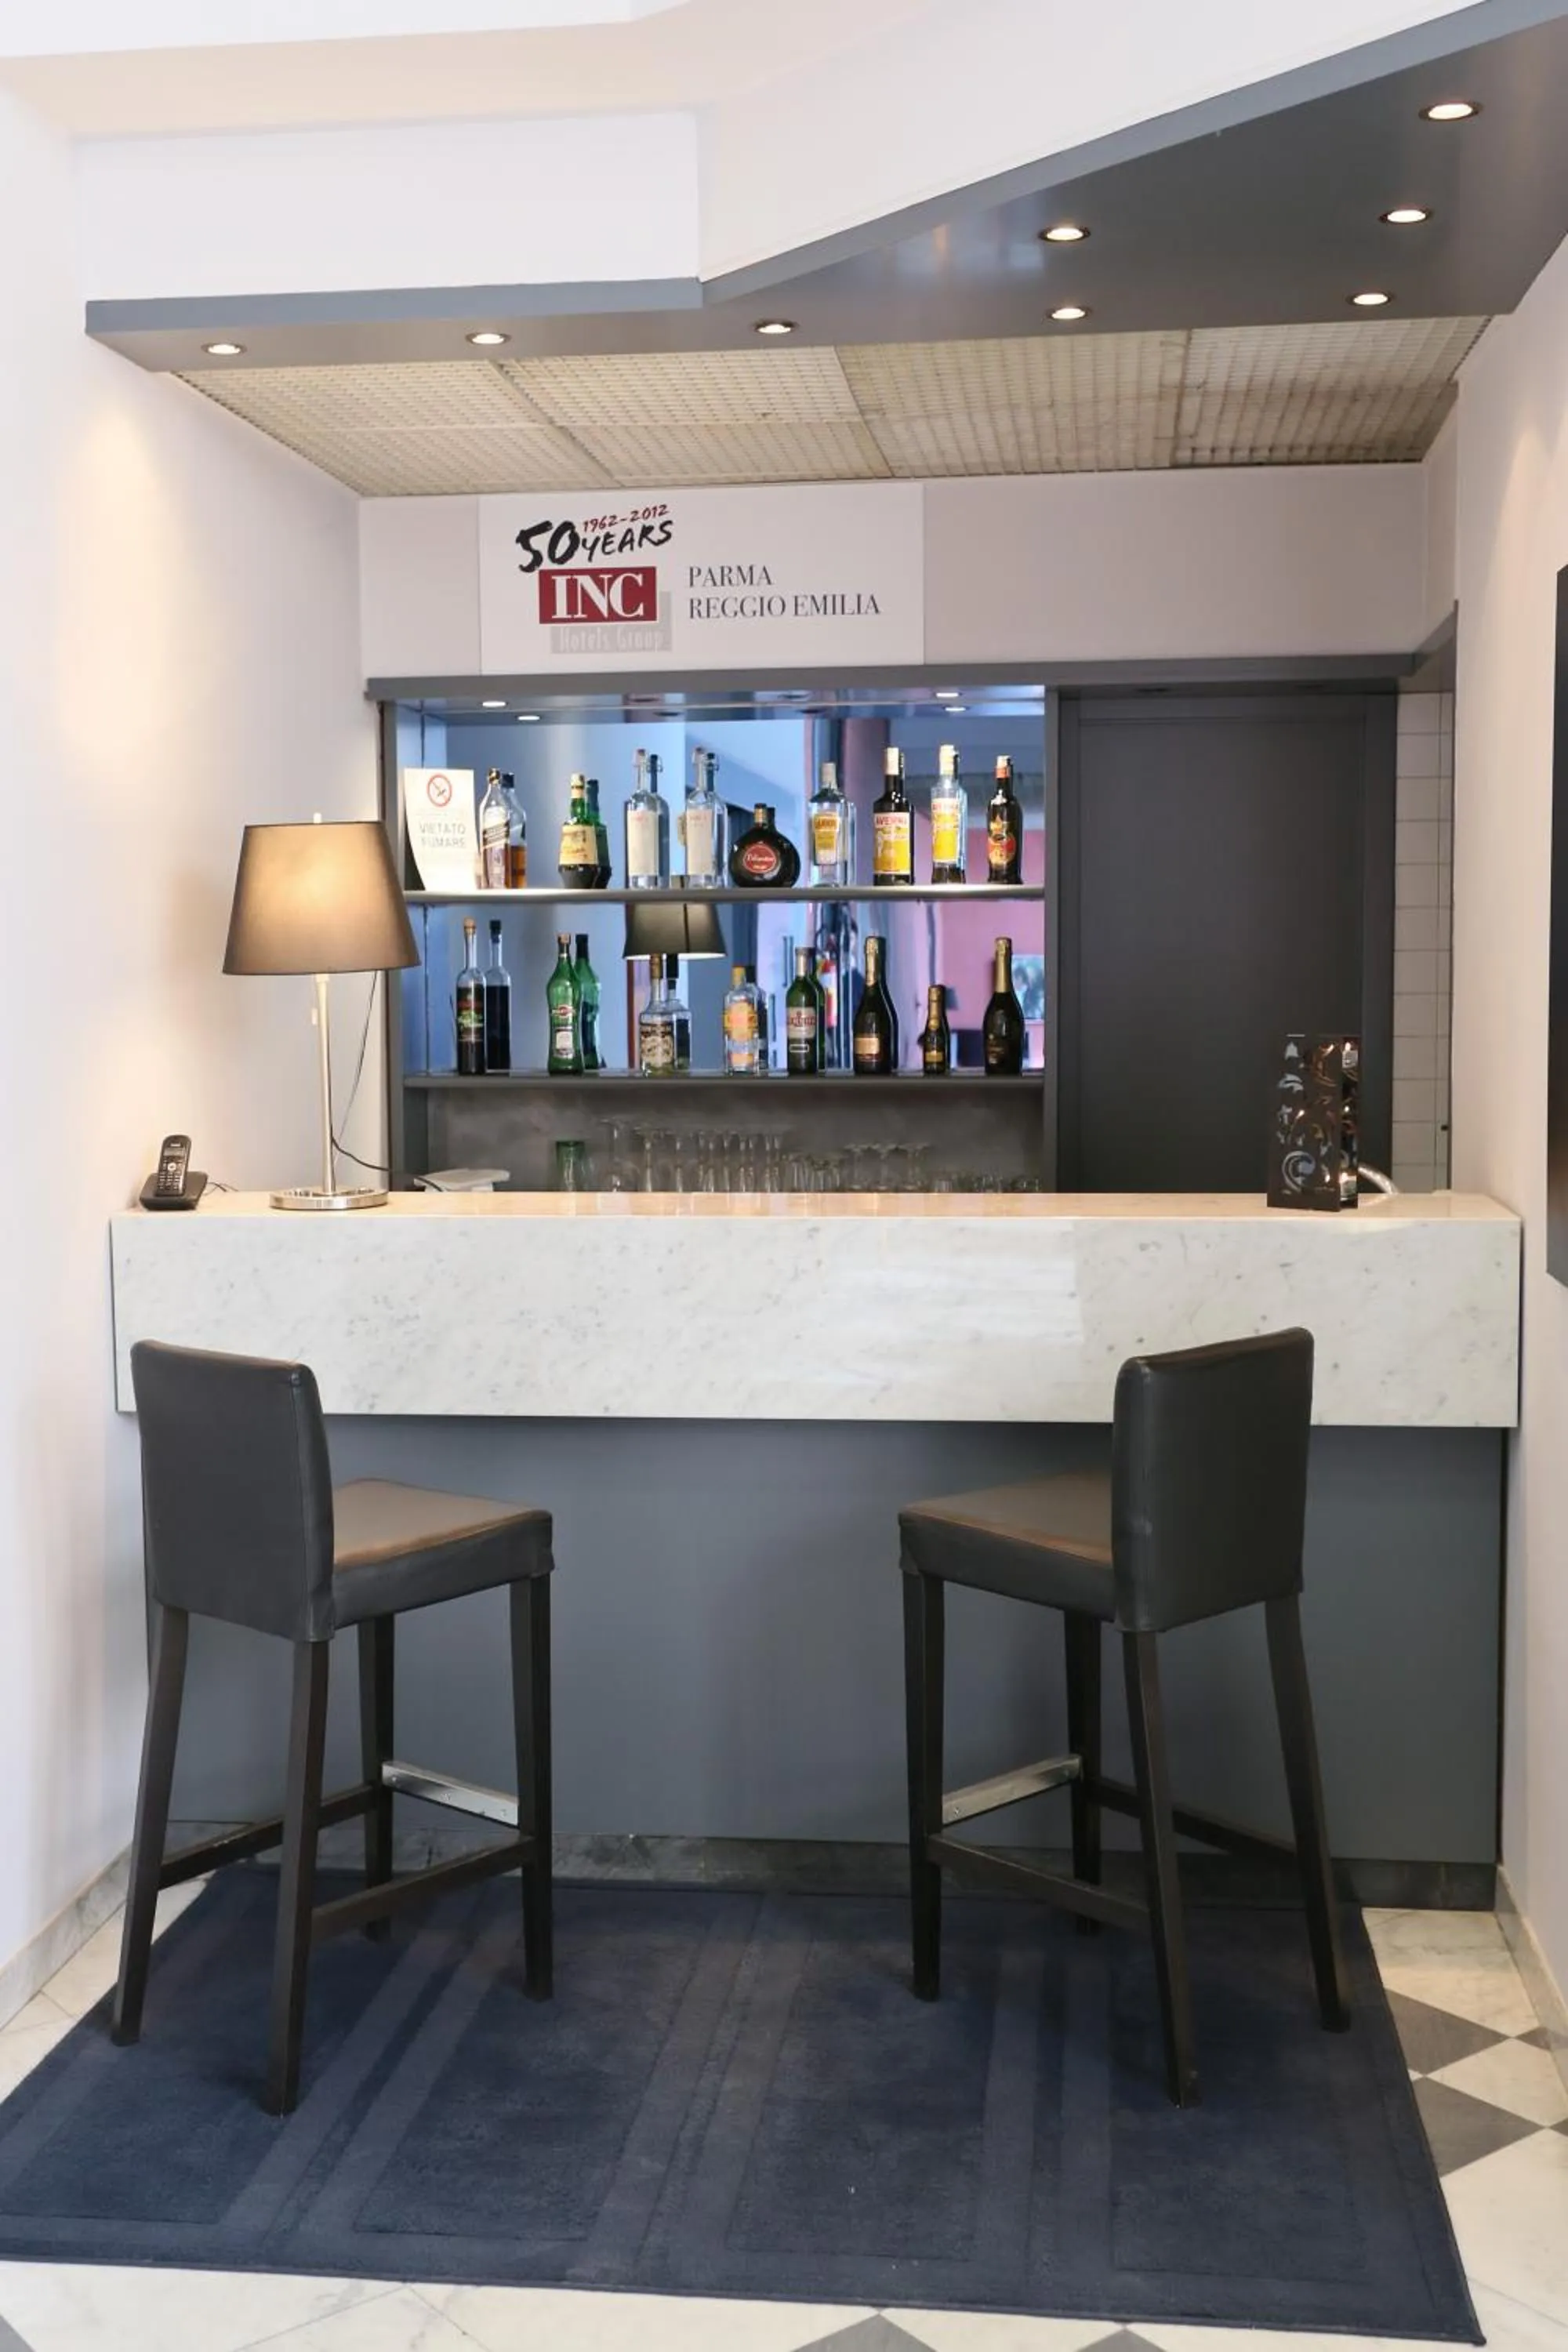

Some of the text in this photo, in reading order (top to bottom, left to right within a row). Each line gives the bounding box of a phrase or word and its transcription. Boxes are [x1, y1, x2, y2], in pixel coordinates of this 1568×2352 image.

[583, 504, 669, 532] 1962-2012
[516, 520, 673, 572] 50 YEARS
[689, 564, 774, 587] PARMA
[552, 573, 644, 619] INC
[689, 593, 880, 619] REGGIO EMILIA
[560, 627, 666, 652] Hotels Group
[419, 822, 466, 834] VIETATO
